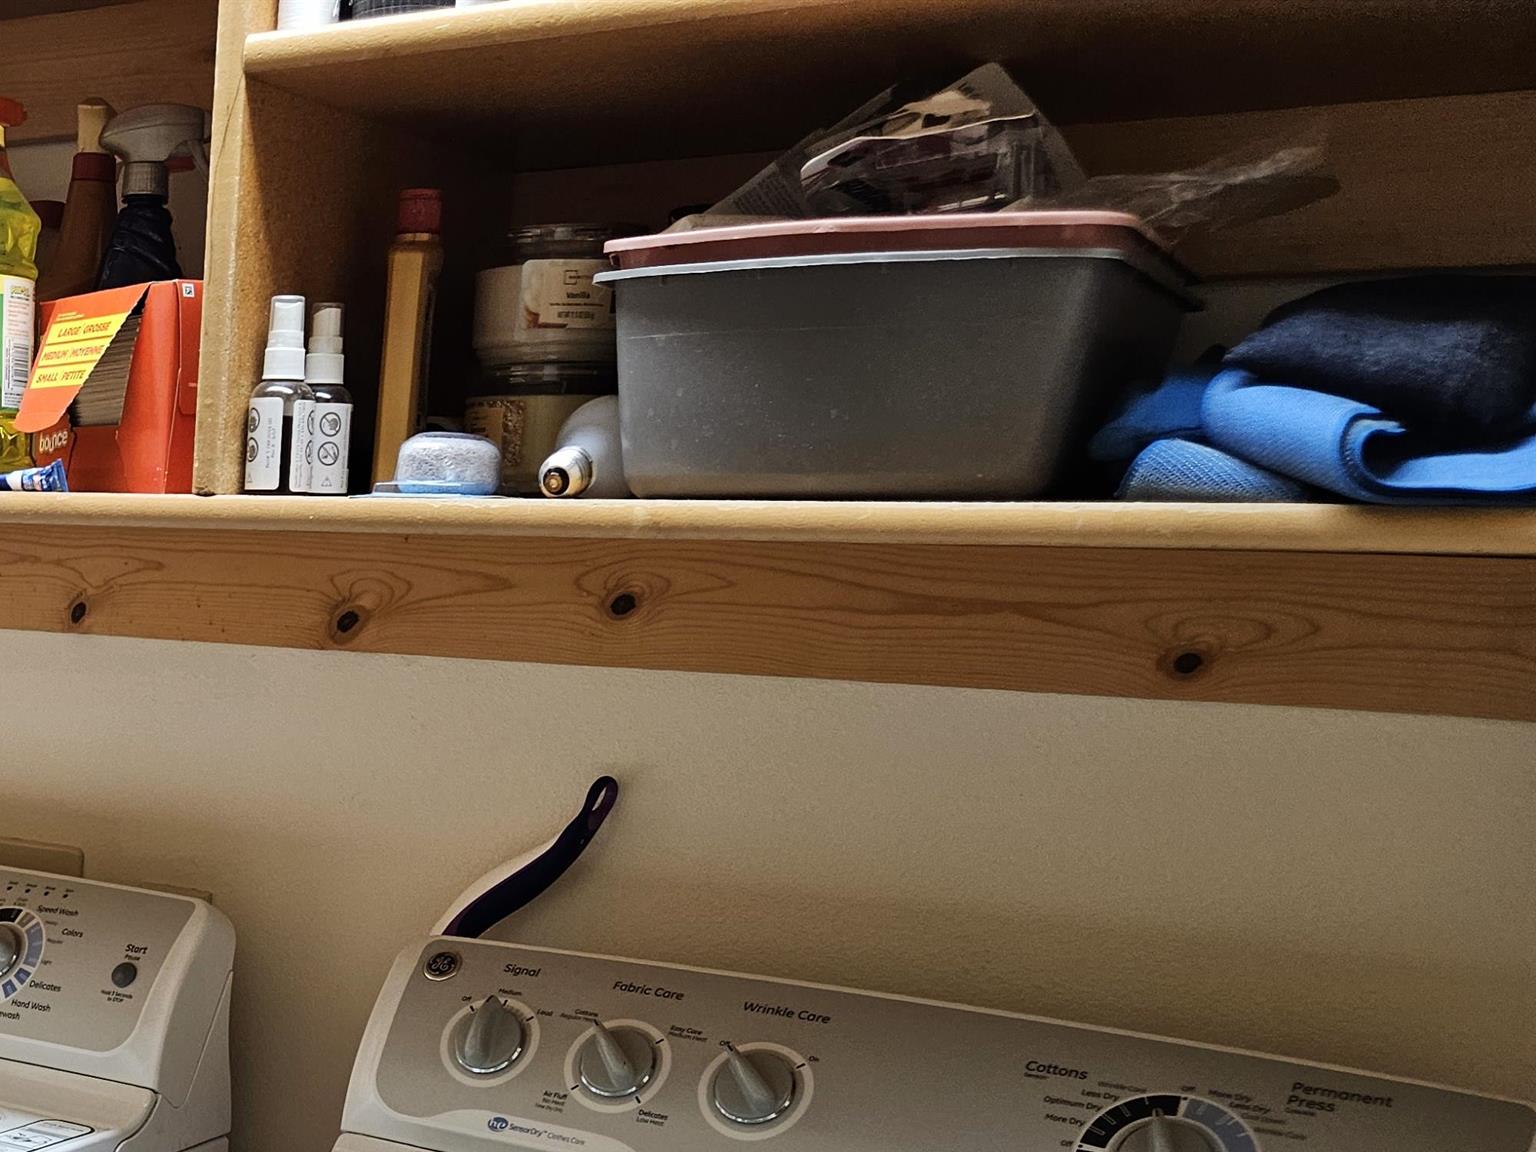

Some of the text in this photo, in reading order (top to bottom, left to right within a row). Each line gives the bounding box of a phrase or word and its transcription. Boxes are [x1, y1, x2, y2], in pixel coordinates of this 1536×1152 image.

[39, 431, 68, 453] bounce
[61, 928, 84, 938] Colors
[125, 944, 148, 955] Start
[504, 963, 541, 978] Signal
[29, 980, 62, 993] Delicates
[613, 981, 685, 1001] Fabric Care
[11, 1000, 51, 1013] Hand Wash
[537, 1008, 554, 1017] Loud
[744, 1001, 832, 1024] Wrinkle Care
[1024, 1060, 1089, 1080] Cottons
[1081, 1089, 1120, 1102] Less Dry
[1290, 1081, 1394, 1108] Permanent
[1287, 1094, 1336, 1112] Press
[638, 1109, 668, 1121] Delicates
[1045, 1113, 1084, 1127] More Dry
